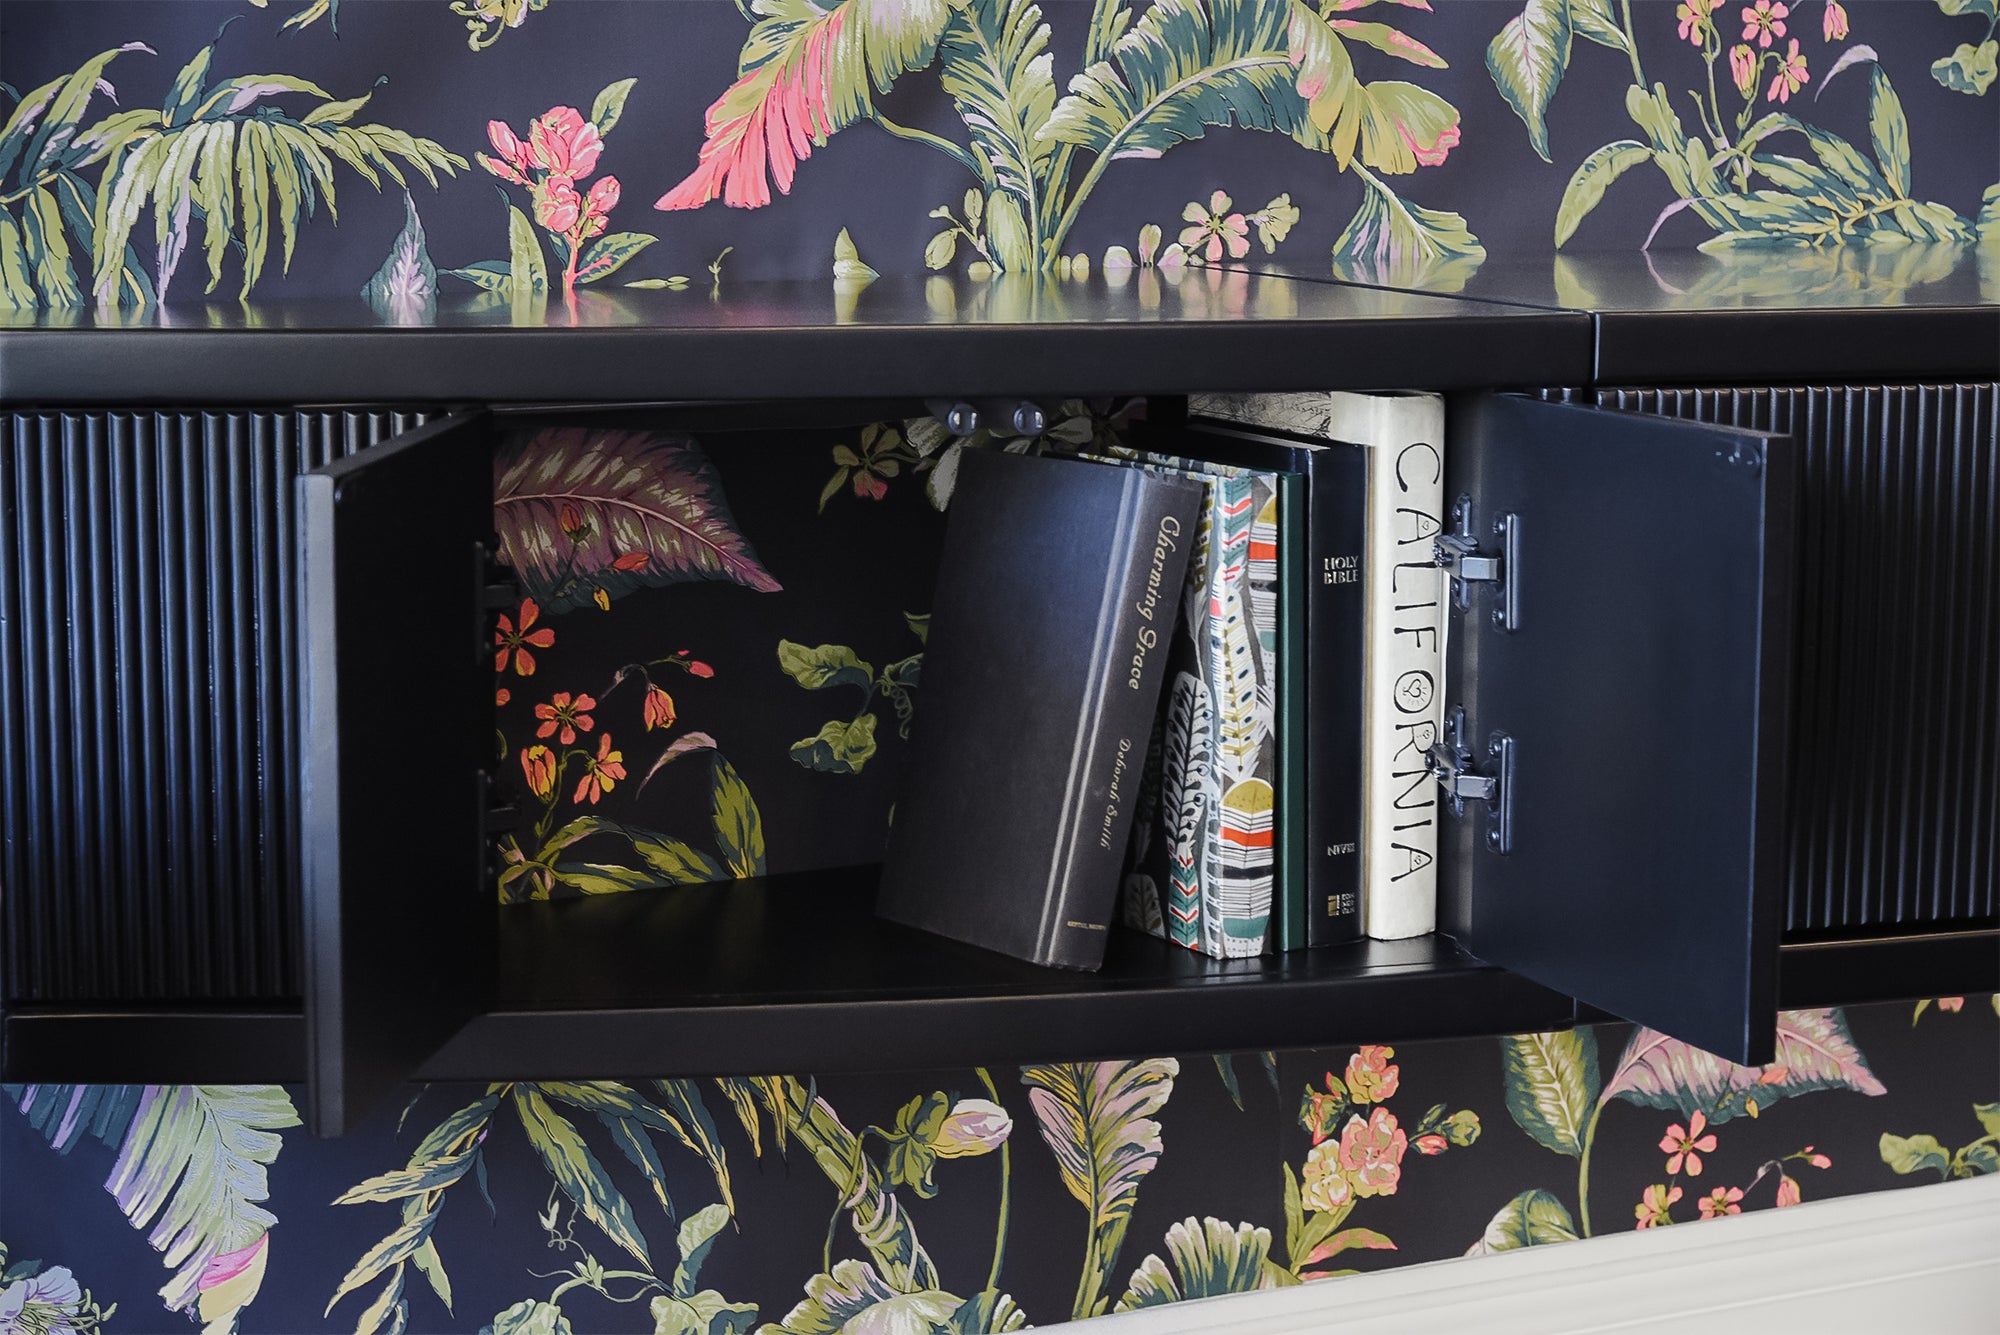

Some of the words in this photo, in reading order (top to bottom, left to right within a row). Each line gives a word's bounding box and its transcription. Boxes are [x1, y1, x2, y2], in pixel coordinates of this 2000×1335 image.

[1137, 515, 1180, 621] Charming
[1323, 569, 1358, 585] BIBLE
[1324, 556, 1358, 570] HOLY
[1128, 626, 1157, 690] Grace
[1391, 443, 1442, 882] CALIFORNIA
[1109, 738, 1132, 803] Deborah
[1100, 804, 1118, 850] Smith
